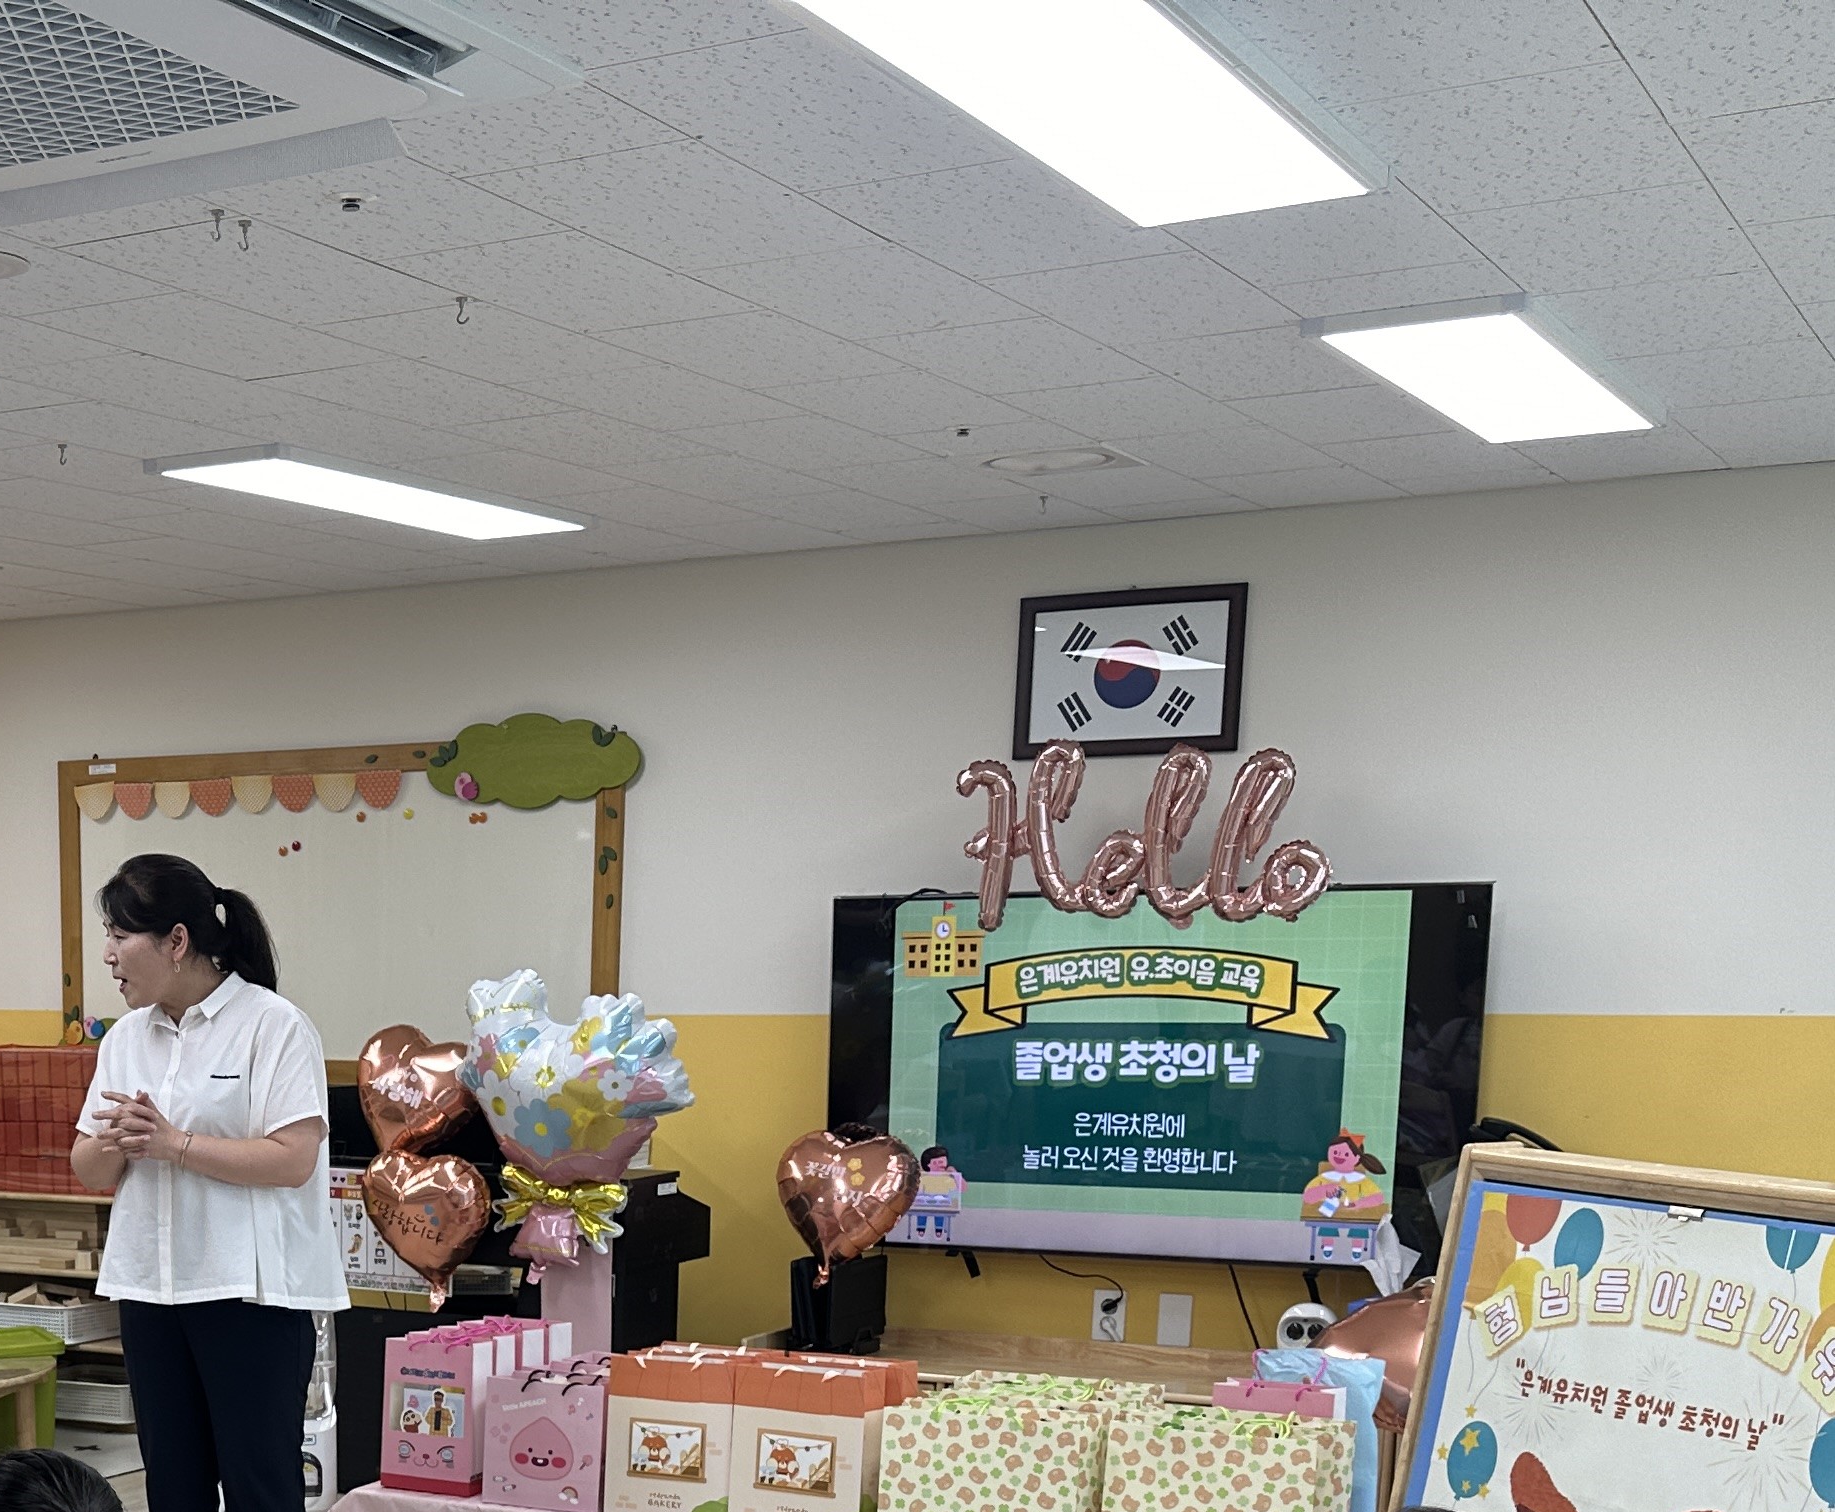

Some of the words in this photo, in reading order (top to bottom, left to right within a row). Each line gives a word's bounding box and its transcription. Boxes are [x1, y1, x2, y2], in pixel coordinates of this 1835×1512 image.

[956, 739, 1333, 931] Hello
[1020, 956, 1120, 994] 은계유치원
[1130, 955, 1215, 985] 유.초이음
[1220, 962, 1260, 993] 교육
[1015, 1041, 1113, 1082] 졸업생
[1118, 1040, 1216, 1083] 초청의
[1224, 1042, 1261, 1083] 날
[1073, 1113, 1185, 1139] 은계유치원에
[1022, 1144, 1059, 1170] 놀러
[1062, 1146, 1098, 1171] 오신
[1102, 1146, 1139, 1173] 것을
[1142, 1147, 1237, 1175] 환영합니다
[373, 1199, 444, 1245] 사랑합니다
[1614, 1388, 1675, 1427] 졸업생
[1678, 1405, 1739, 1439] 초청의
[648, 1499, 682, 1509] BAKERY
